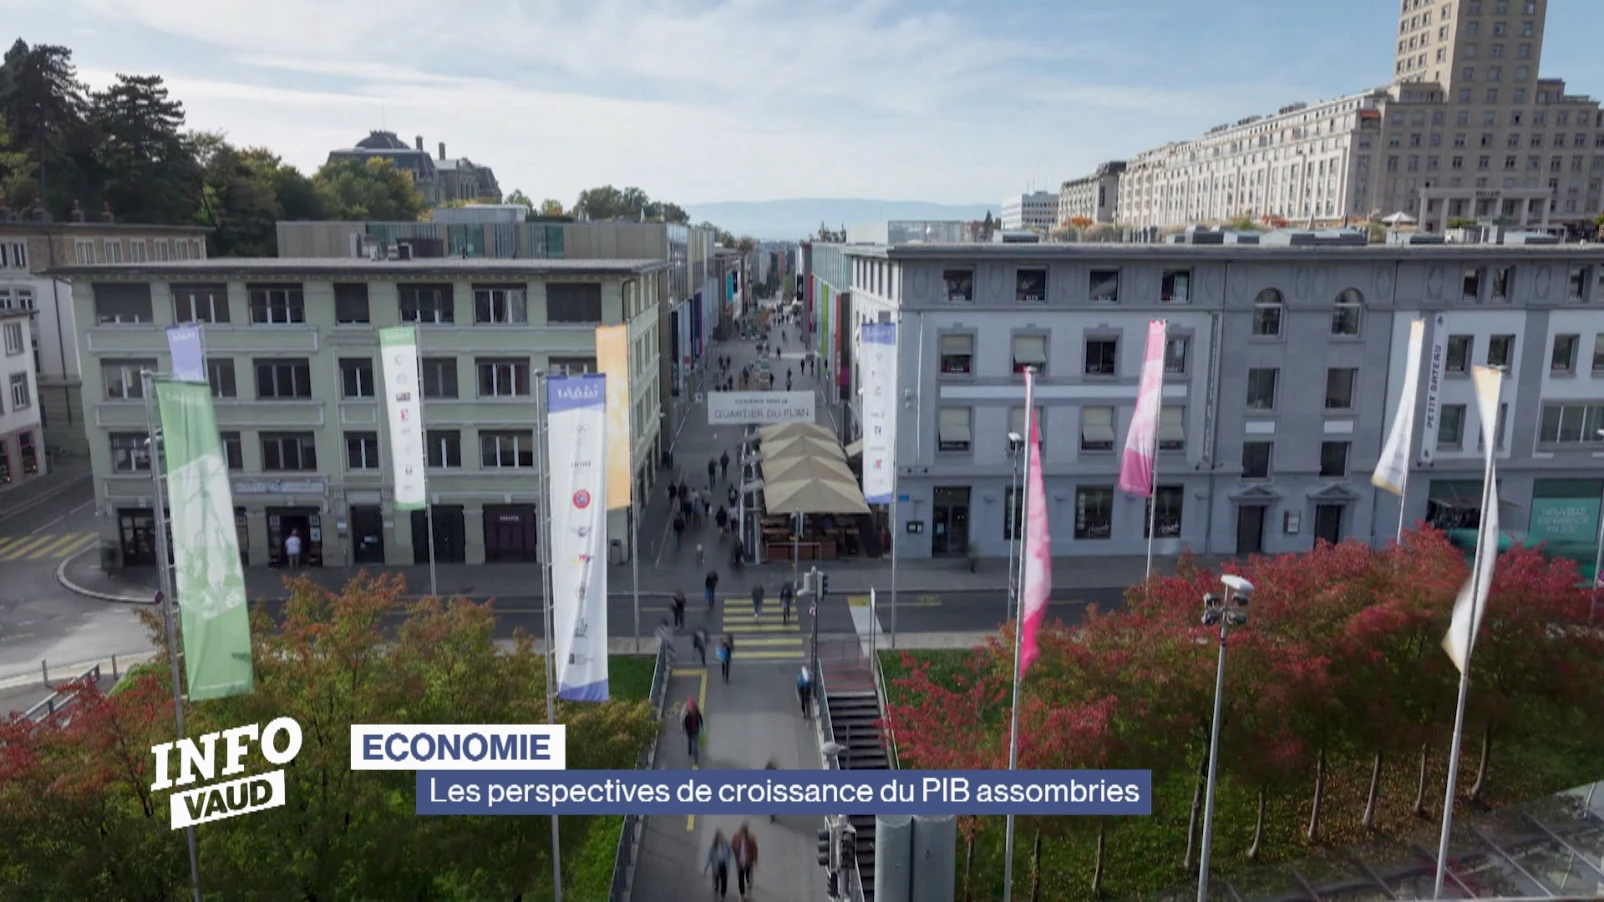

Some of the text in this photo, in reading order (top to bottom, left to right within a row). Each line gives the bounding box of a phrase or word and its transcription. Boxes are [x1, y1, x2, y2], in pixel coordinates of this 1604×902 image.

[1426, 344, 1442, 428] PETIT BATEAU
[714, 408, 764, 420] QUARTIER
[766, 408, 781, 420] DU
